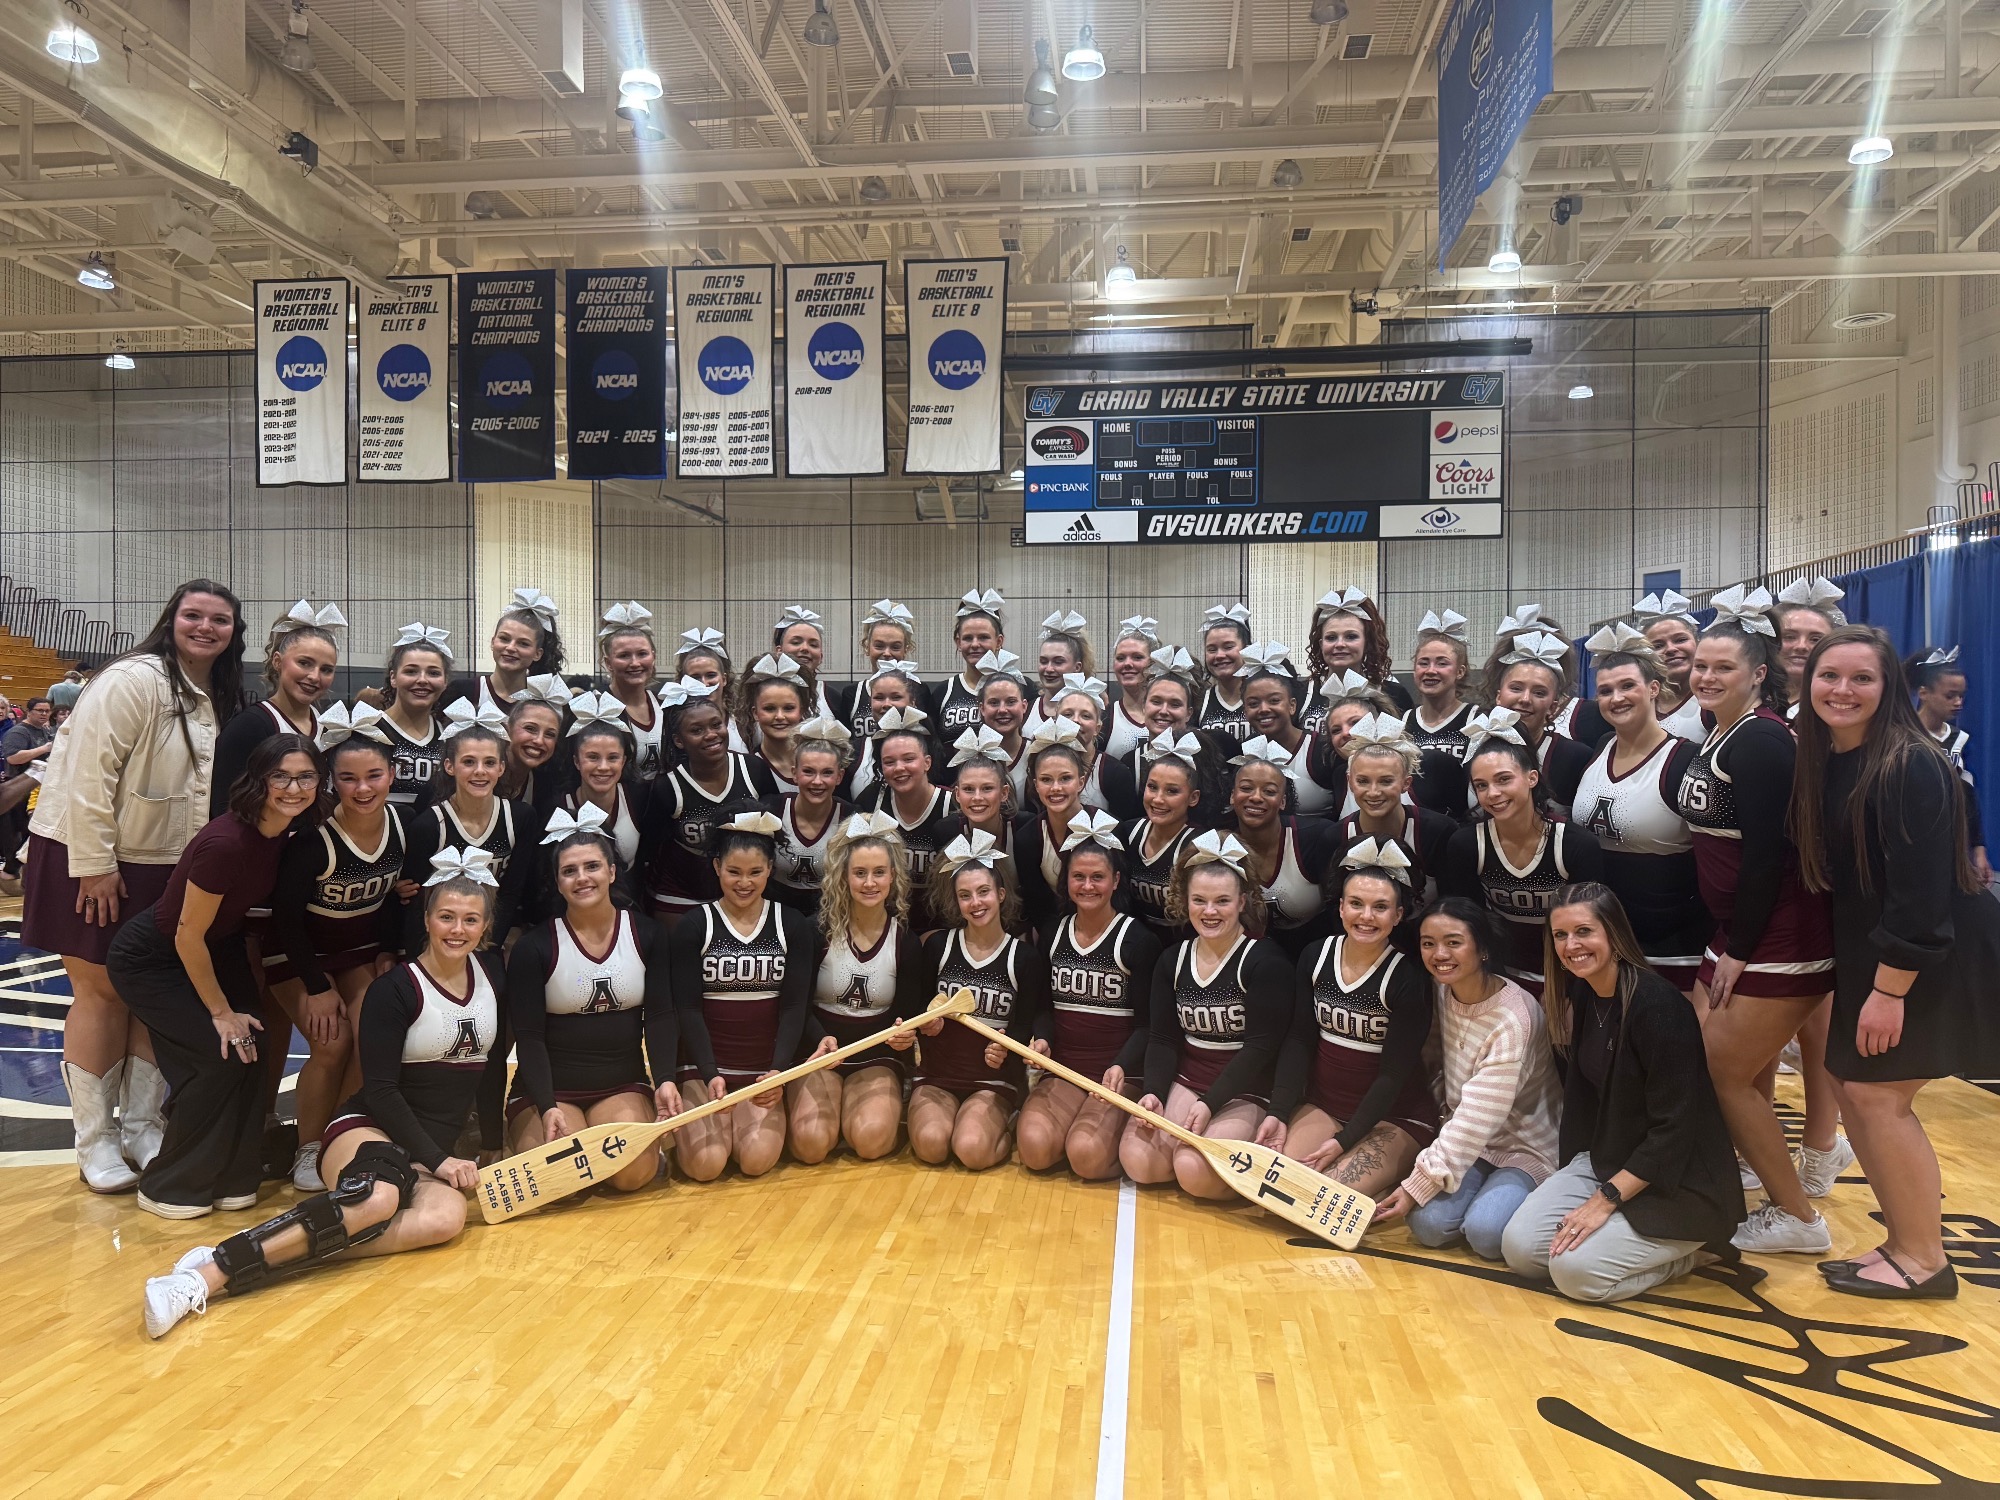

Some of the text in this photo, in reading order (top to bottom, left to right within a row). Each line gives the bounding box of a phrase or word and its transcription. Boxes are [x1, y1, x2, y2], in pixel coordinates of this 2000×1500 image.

[702, 275, 745, 289] MEN'S
[814, 272, 856, 286] MEN'S
[935, 269, 978, 282] MEN'S
[477, 281, 534, 296] WOMEN'S
[587, 276, 647, 290] WOMEN'S
[273, 288, 332, 301] WOMEN'S
[576, 290, 654, 304] BASKETBALL
[686, 292, 762, 306] BASKETBALL
[795, 286, 874, 302] BASKETBALL
[918, 286, 994, 300] BASKETBALL
[263, 302, 338, 317] BASKETBALL
[368, 301, 439, 315] BASKETBALL
[470, 297, 543, 312] BASKETBALL
[584, 305, 645, 318] NATIONAL
[804, 303, 866, 318] REGIONAL
[932, 304, 980, 318] ELITE 8
[478, 314, 533, 329] NATIONAL
[696, 309, 754, 323] REGIONAL
[272, 318, 330, 332] REGIONAL
[381, 318, 427, 332] ELITE 8
[576, 319, 654, 332] CHAMPIONS
[471, 330, 540, 345] CHAMPIONS
[814, 350, 862, 366] NCAA
[282, 363, 326, 378] NCAA
[705, 365, 752, 381] NCAA
[934, 360, 984, 376] NCAA
[383, 372, 429, 388] NCAA
[596, 374, 638, 388] NCAA
[486, 380, 532, 397] NCAA
[795, 387, 832, 395] 2018-2019
[1078, 380, 1446, 411] GRAND VALLEY STATE UNIVERSITY
[682, 410, 770, 420] 1984-1985 2005-2006
[910, 405, 954, 413] 2006-2007
[362, 416, 404, 424] 2004-2005
[471, 417, 541, 431] 2005-2006
[682, 422, 770, 432] 1990-1991 2006-2007
[910, 417, 952, 425] 2007-2008
[1217, 420, 1254, 430] VISITOR
[362, 427, 404, 436] 2005-2006
[1102, 423, 1130, 432] HOME
[1461, 424, 1498, 438] pepsi
[362, 439, 404, 448] 2015-2016
[576, 430, 610, 444] 2024
[622, 430, 657, 443] 2025
[682, 434, 770, 444] 1991-1992 2007-2008
[1036, 438, 1072, 446] TOMMY'S
[362, 450, 403, 459] 2021-2022
[728, 446, 770, 455] 2008-2009
[728, 458, 768, 466] 2009-2010
[1114, 460, 1138, 468] BONUS
[1156, 454, 1182, 462] PERIOD
[1214, 458, 1238, 466] BONUS
[362, 462, 402, 471] 2024-2025
[1436, 462, 1495, 484] Coors
[1148, 472, 1174, 480] PLAYER
[1186, 472, 1208, 480] FOULS
[1230, 470, 1252, 478] FOULS
[1442, 484, 1488, 495] LIGHT
[1131, 498, 1144, 506] TOL
[1147, 510, 1368, 536] GVSULAKERS.COM
[1062, 530, 1101, 541] adidas
[944, 706, 981, 728] SCO
[1584, 796, 1620, 839] A
[787, 855, 819, 883] A
[322, 867, 401, 904] SCOT
[702, 956, 786, 982] SCOTS
[1052, 966, 1123, 1000] SCOTS
[580, 977, 622, 1014] A
[837, 974, 872, 1008] A
[442, 1018, 482, 1059] A
[508, 1168, 524, 1202] CHEER
[522, 1162, 540, 1198] LAKER
[484, 1182, 498, 1208] 2026
[494, 1168, 514, 1212] CLASSIC
[1306, 1186, 1328, 1218] LAKER
[1320, 1193, 1342, 1226] CHEER
[1330, 1194, 1356, 1236] CLASSIC
[1345, 1208, 1362, 1234] 2026
